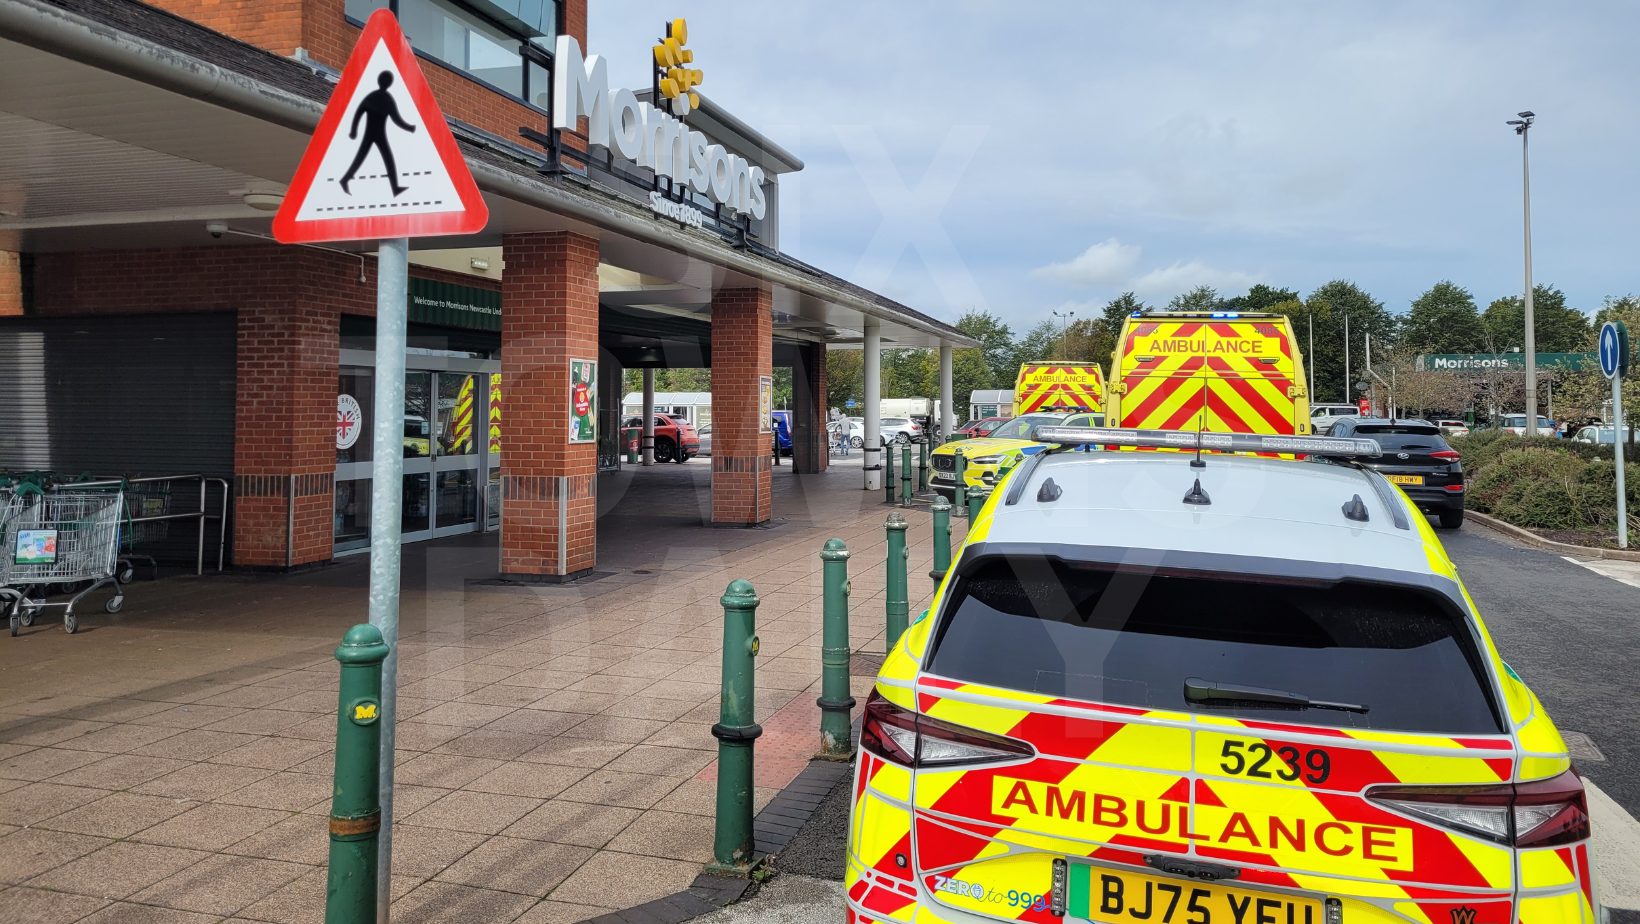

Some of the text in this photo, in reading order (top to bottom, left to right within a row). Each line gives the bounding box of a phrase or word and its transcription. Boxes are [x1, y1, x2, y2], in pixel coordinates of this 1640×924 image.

[554, 34, 766, 221] Morrisons
[650, 191, 703, 228] Since 1899
[413, 296, 438, 306] Welcome
[439, 300, 445, 308] to
[446, 301, 469, 311] Morrisons
[469, 304, 491, 314] Newcastle
[1149, 339, 1263, 354] AMBULANCE
[1434, 355, 1509, 369] Morrisons
[1033, 375, 1087, 383] AMBULANCE
[341, 397, 361, 420] BRITISH
[1220, 739, 1331, 784] 5239
[1000, 780, 1399, 864] AMBULANCE
[934, 875, 1046, 912] ZERO to 999
[1100, 874, 1211, 924] BJ75
